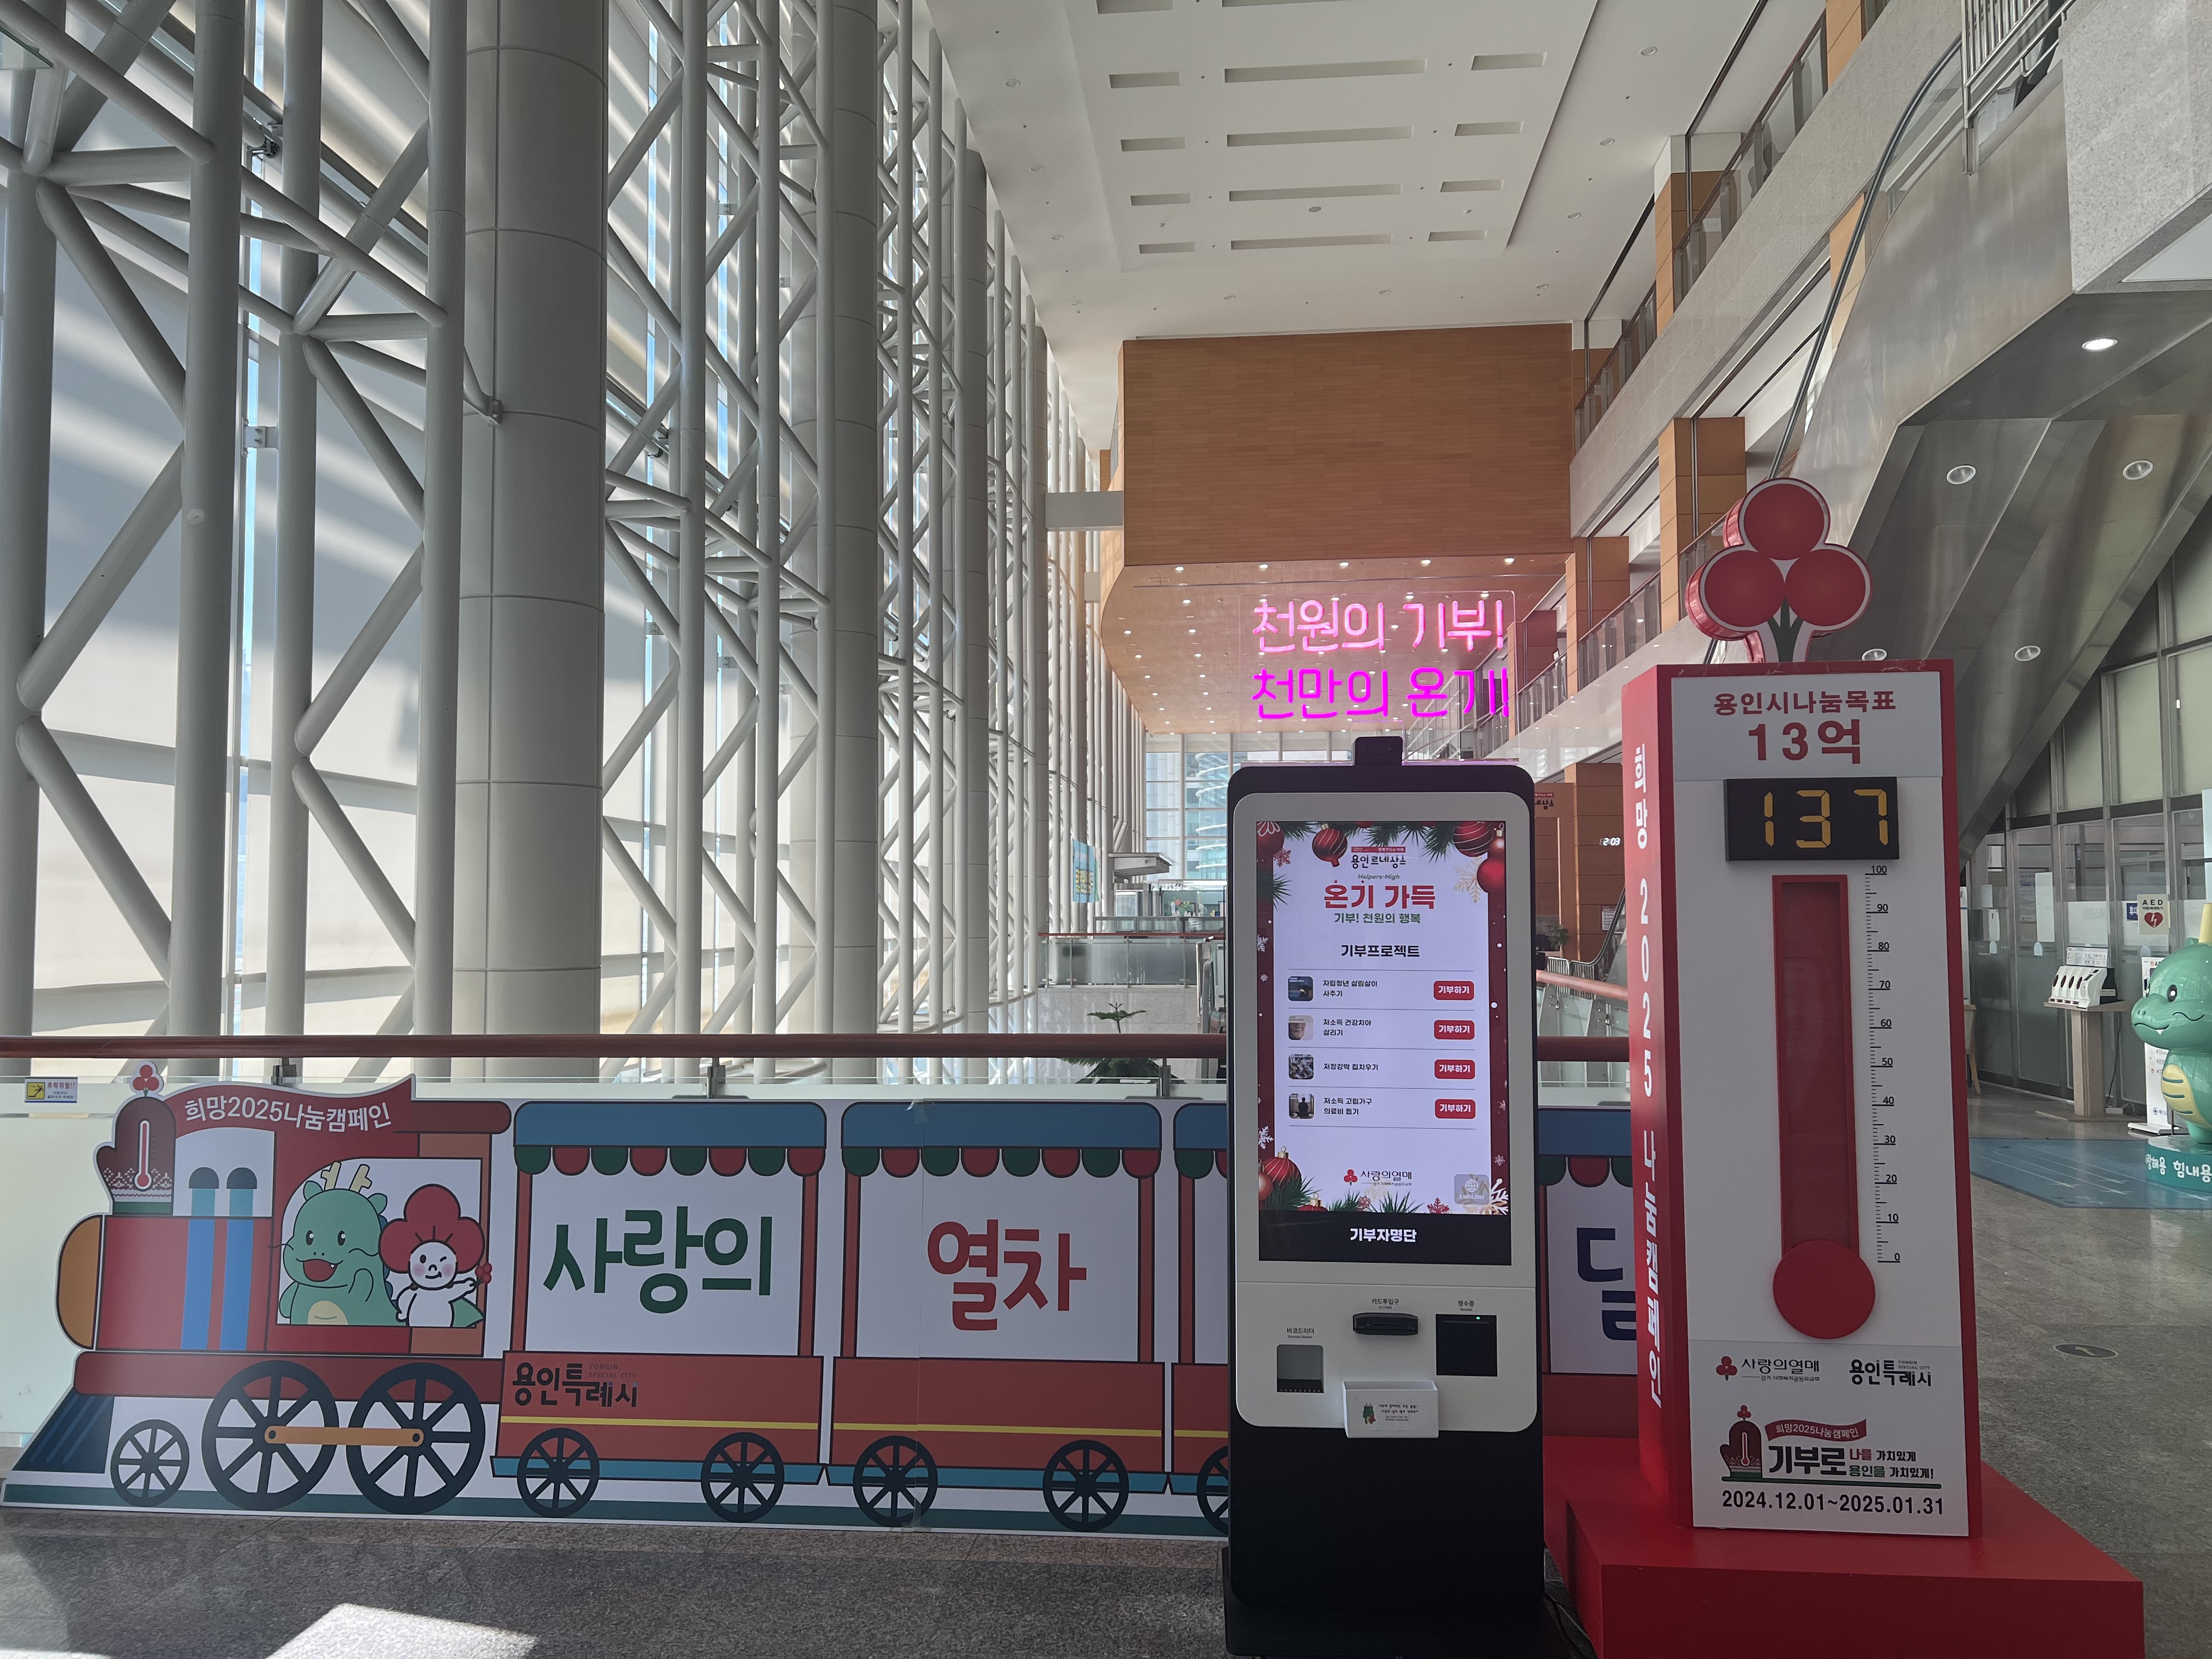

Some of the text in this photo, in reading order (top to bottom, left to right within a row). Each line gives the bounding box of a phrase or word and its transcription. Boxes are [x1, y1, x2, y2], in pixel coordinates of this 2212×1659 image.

[1252, 600, 1504, 652] 천원의 기부!
[1251, 667, 1509, 719] 천만의 온기!
[1714, 690, 1897, 716] 용인시나눔목표
[1748, 719, 1861, 765] 13억
[1764, 789, 1889, 848] 137
[1351, 855, 1406, 869] 용인 르네상스
[1324, 880, 1436, 909] 온기 가득
[1334, 913, 1421, 924] 기부! 천원의 행복
[1341, 944, 1420, 957] 기부프로젝트
[1438, 985, 1470, 995] 기부하기
[1438, 1024, 1470, 1034] 기부하기
[1439, 1064, 1471, 1073] 기부하기
[184, 1096, 392, 1133] 희망2025나눔캠페인
[1440, 1103, 1471, 1113] 기부하기
[1360, 1170, 1412, 1181] 사랑의열매
[1350, 1228, 1417, 1243] 기부자명단
[543, 1206, 772, 1314] 사랑의
[927, 1219, 1087, 1331] 열차
[1741, 1358, 1819, 1374] 사랑의열매
[1849, 1359, 1931, 1386] 용인특례시
[512, 1362, 637, 1407] 용인특례시
[1775, 1423, 1859, 1438] 희망2025나눔캠페인
[1768, 1446, 1847, 1476] 기부로
[1849, 1448, 1916, 1462] 나를 가치있게
[1849, 1465, 1934, 1479] 용인을 가치있게!
[1722, 1490, 1944, 1515] 2024.12.01~2025.01.31
